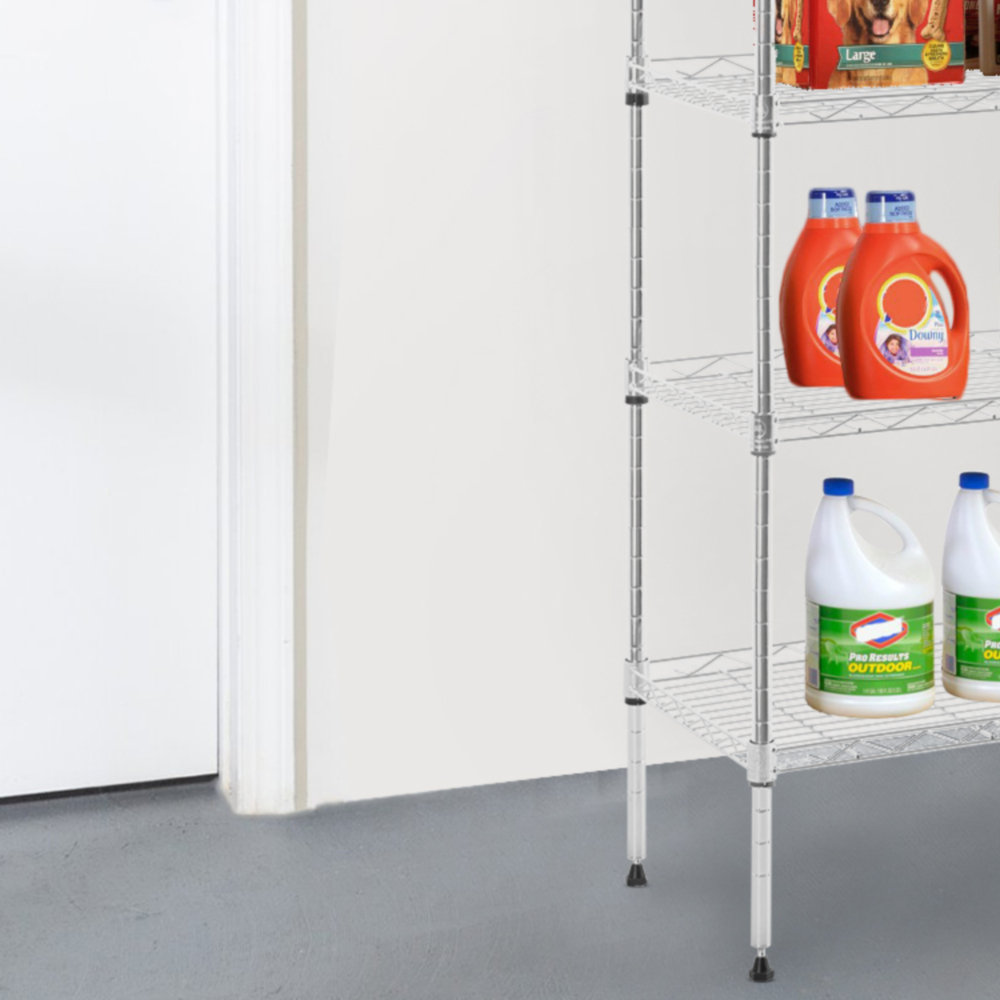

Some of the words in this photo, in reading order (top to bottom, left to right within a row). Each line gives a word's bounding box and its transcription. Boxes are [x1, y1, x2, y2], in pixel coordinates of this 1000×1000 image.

[846, 48, 876, 63] Large
[909, 328, 944, 343] Downy
[848, 652, 868, 662] PRO
[869, 652, 910, 662] RESULTS
[847, 661, 913, 674] OUTDOOR
